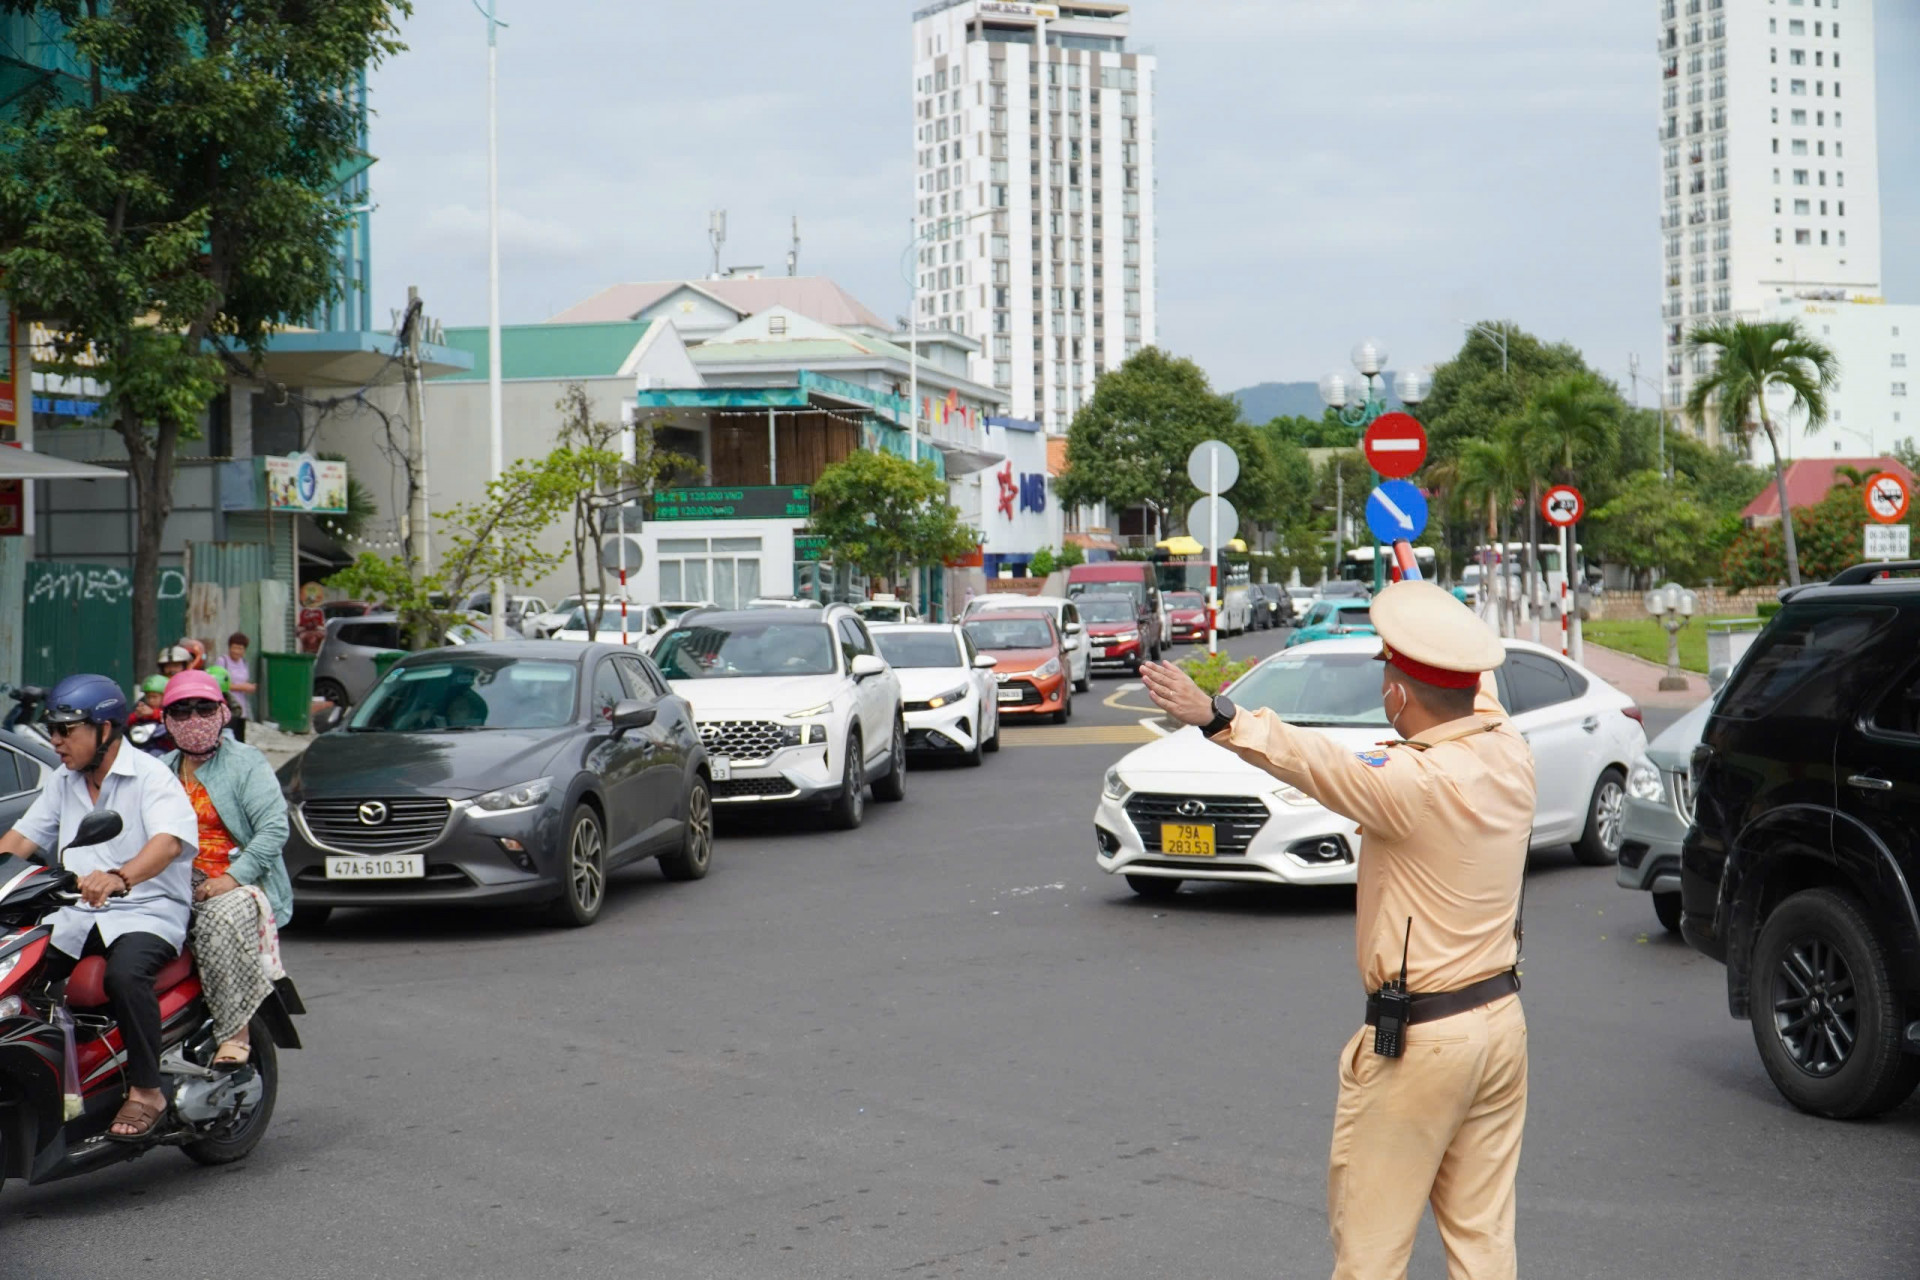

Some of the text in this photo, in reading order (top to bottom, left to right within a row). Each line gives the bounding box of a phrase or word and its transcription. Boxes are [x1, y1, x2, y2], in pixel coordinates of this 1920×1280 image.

[1020, 472, 1046, 513] MB
[1177, 825, 1200, 839] 79A
[1168, 839, 1210, 854] 283.53
[334, 860, 413, 875] 47A-610.31
